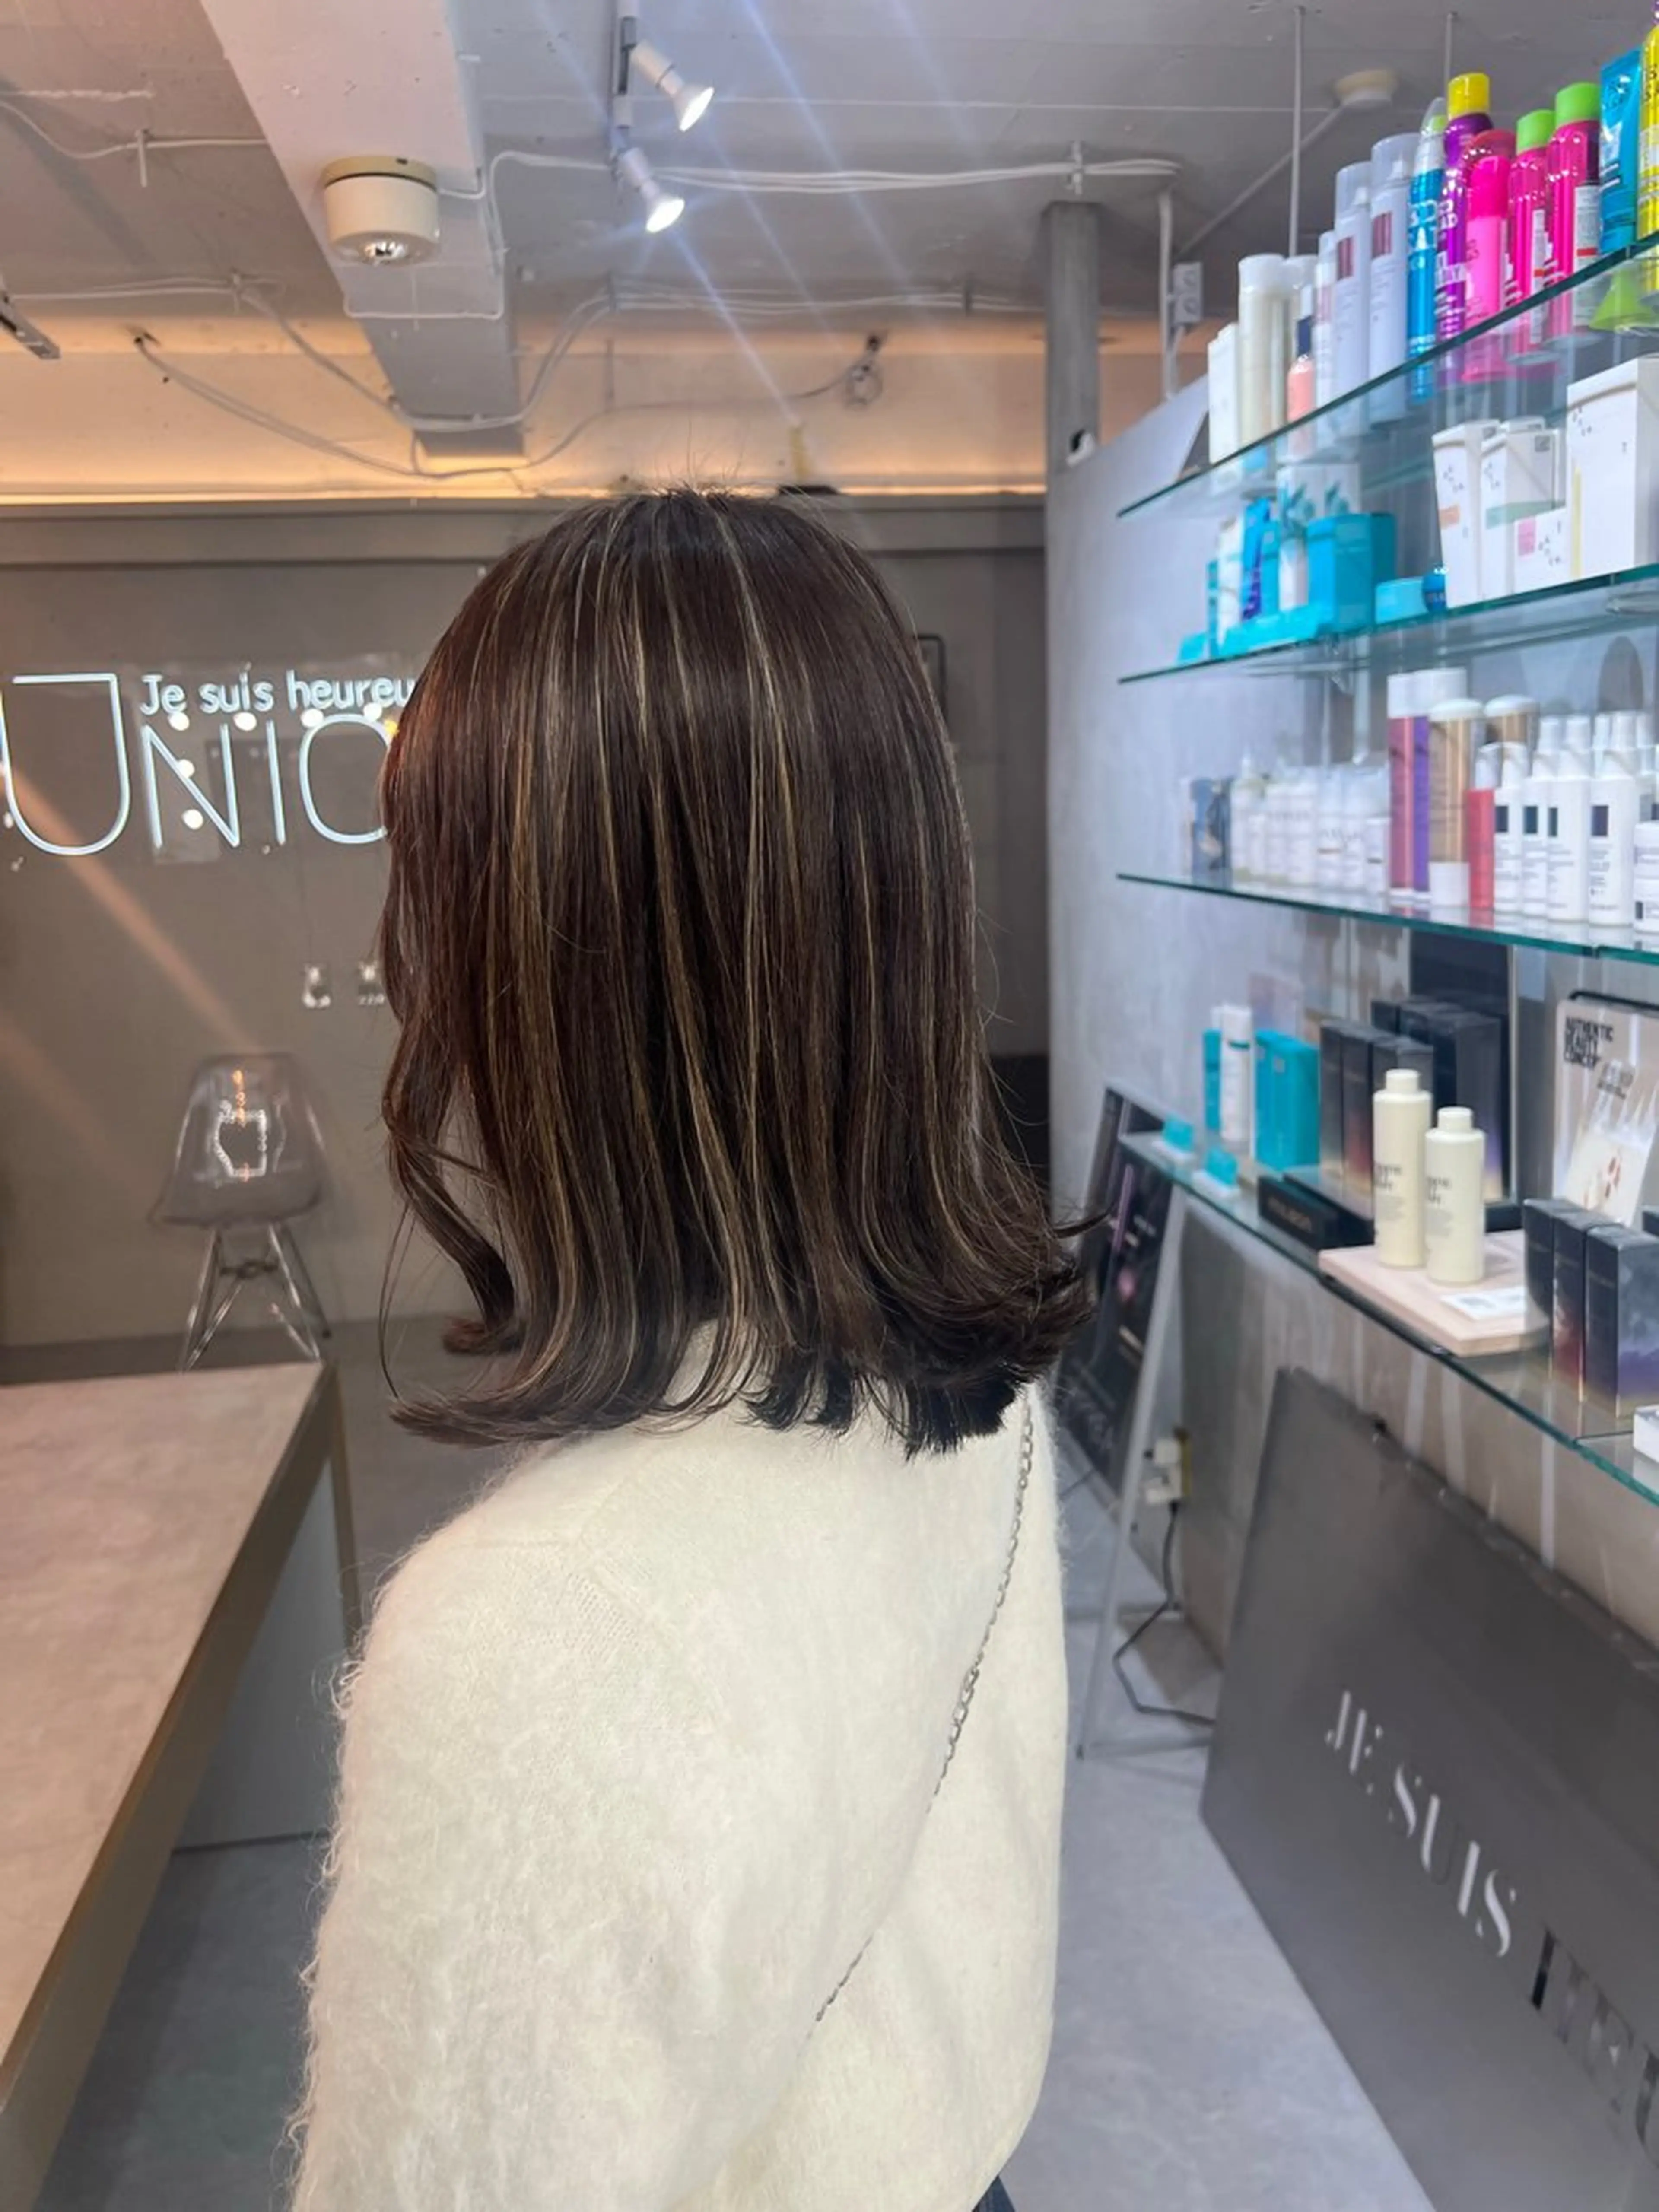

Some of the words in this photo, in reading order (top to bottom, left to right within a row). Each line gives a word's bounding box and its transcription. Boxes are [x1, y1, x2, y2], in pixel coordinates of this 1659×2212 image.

[140, 674, 187, 715] Je
[199, 671, 274, 712] suis
[1324, 1690, 1383, 1796] JE
[1386, 1760, 1517, 1958] SUIS
